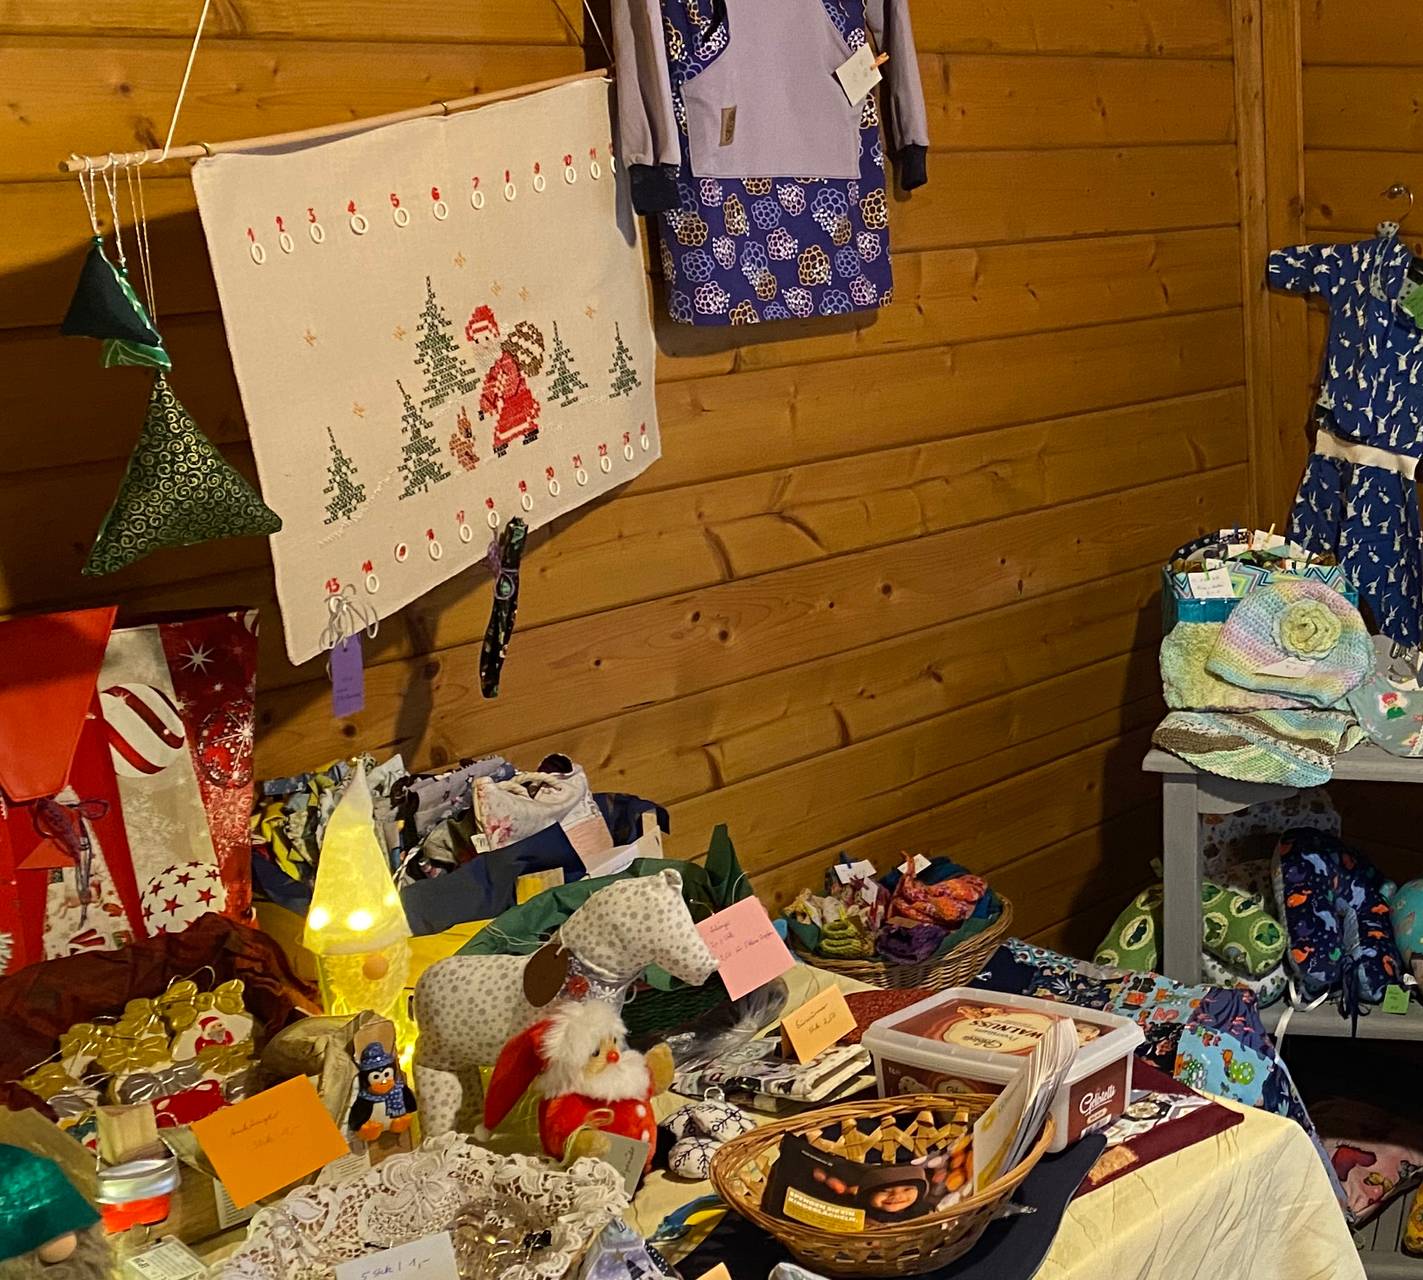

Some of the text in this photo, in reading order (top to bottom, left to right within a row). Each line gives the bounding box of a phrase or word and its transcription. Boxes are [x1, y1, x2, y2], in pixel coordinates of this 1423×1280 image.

[275, 215, 285, 232] 2
[307, 207, 317, 223] 3
[346, 199, 357, 215] 4
[389, 192, 400, 208] 5
[431, 186, 441, 201] 6
[472, 176, 480, 190] 7
[325, 577, 341, 593] 13
[969, 1020, 1044, 1039] WALNUSS
